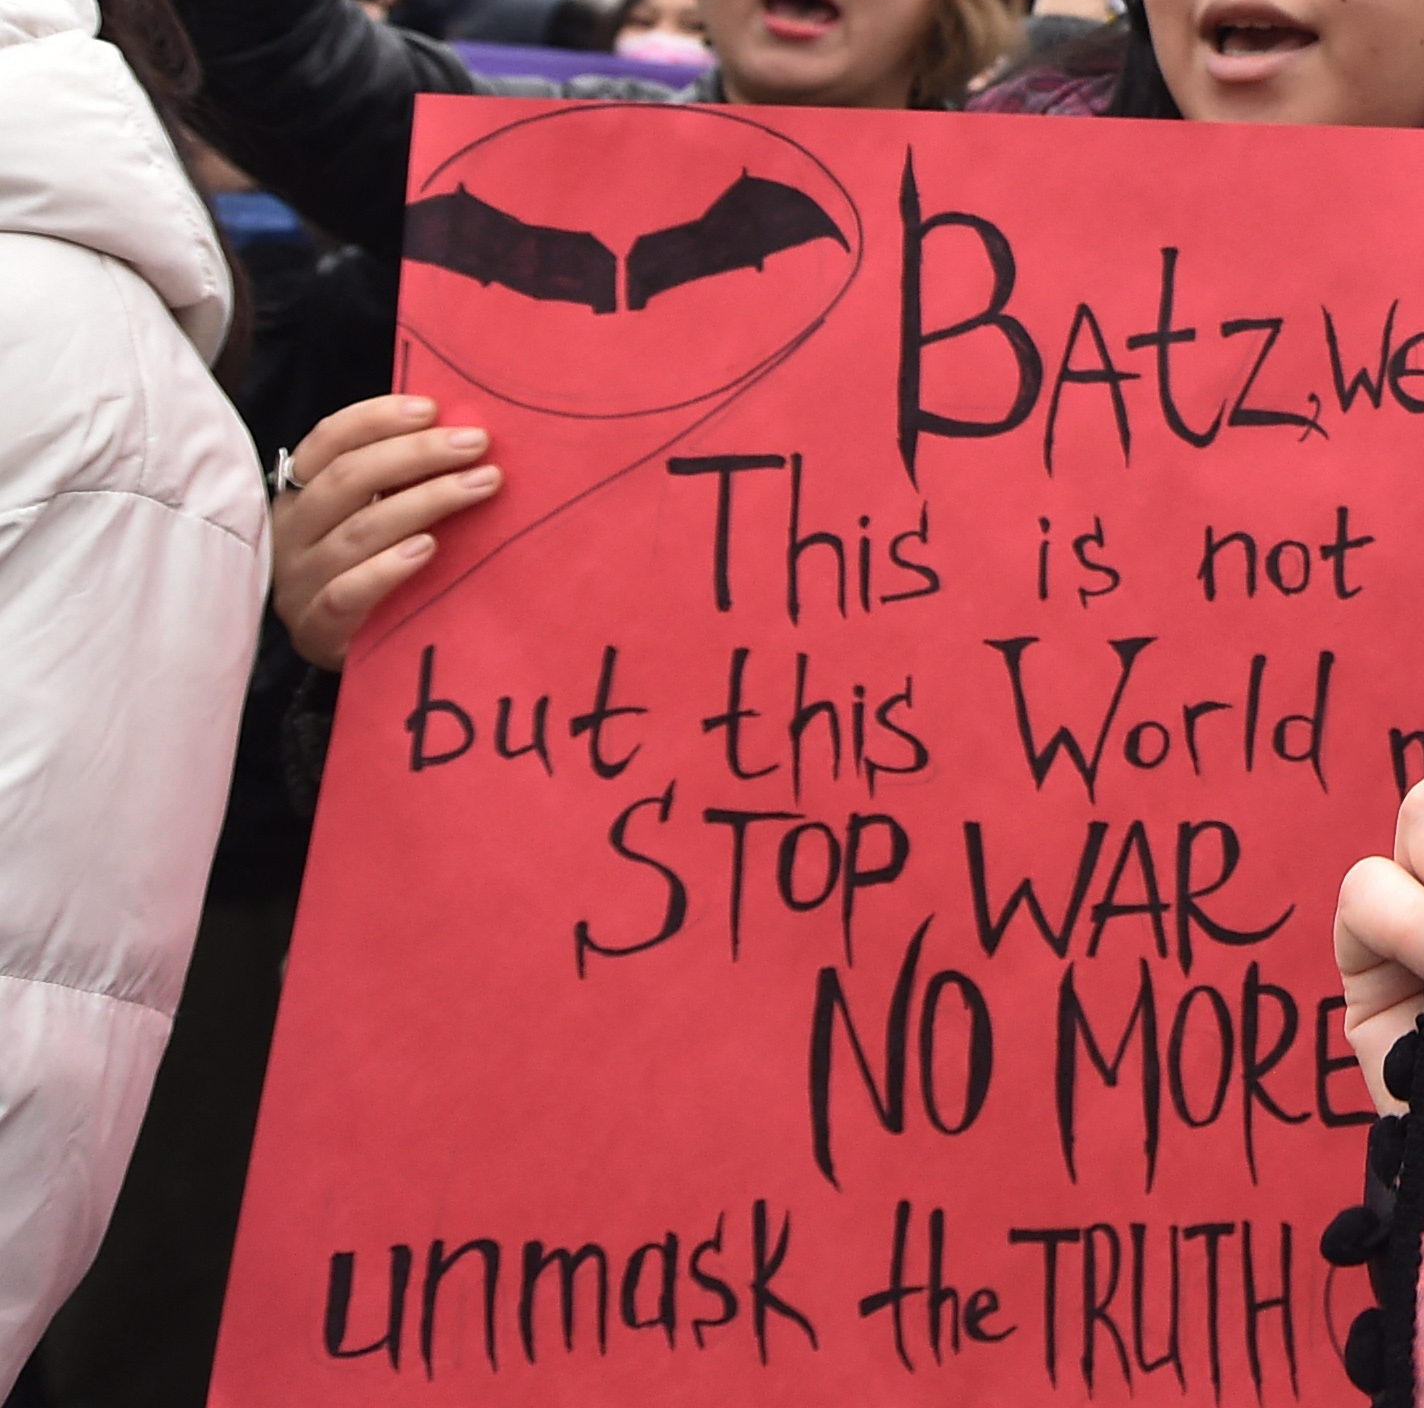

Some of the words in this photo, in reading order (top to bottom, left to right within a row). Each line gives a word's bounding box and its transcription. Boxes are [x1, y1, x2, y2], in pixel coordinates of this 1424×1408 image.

[667, 453, 940, 627] This
[1037, 514, 1121, 609] is
[1197, 506, 1375, 602] not
[406, 644, 648, 780] but
[702, 647, 929, 799] this
[985, 637, 1334, 804] World
[573, 779, 910, 978] STOP
[964, 819, 1294, 975] WAR
[810, 914, 993, 1190] NO
[1056, 960, 1379, 1194] MORE
[323, 1198, 817, 1381] unmask
[859, 1200, 1016, 1372] the
[1009, 1222, 1300, 1404] TRUTH
